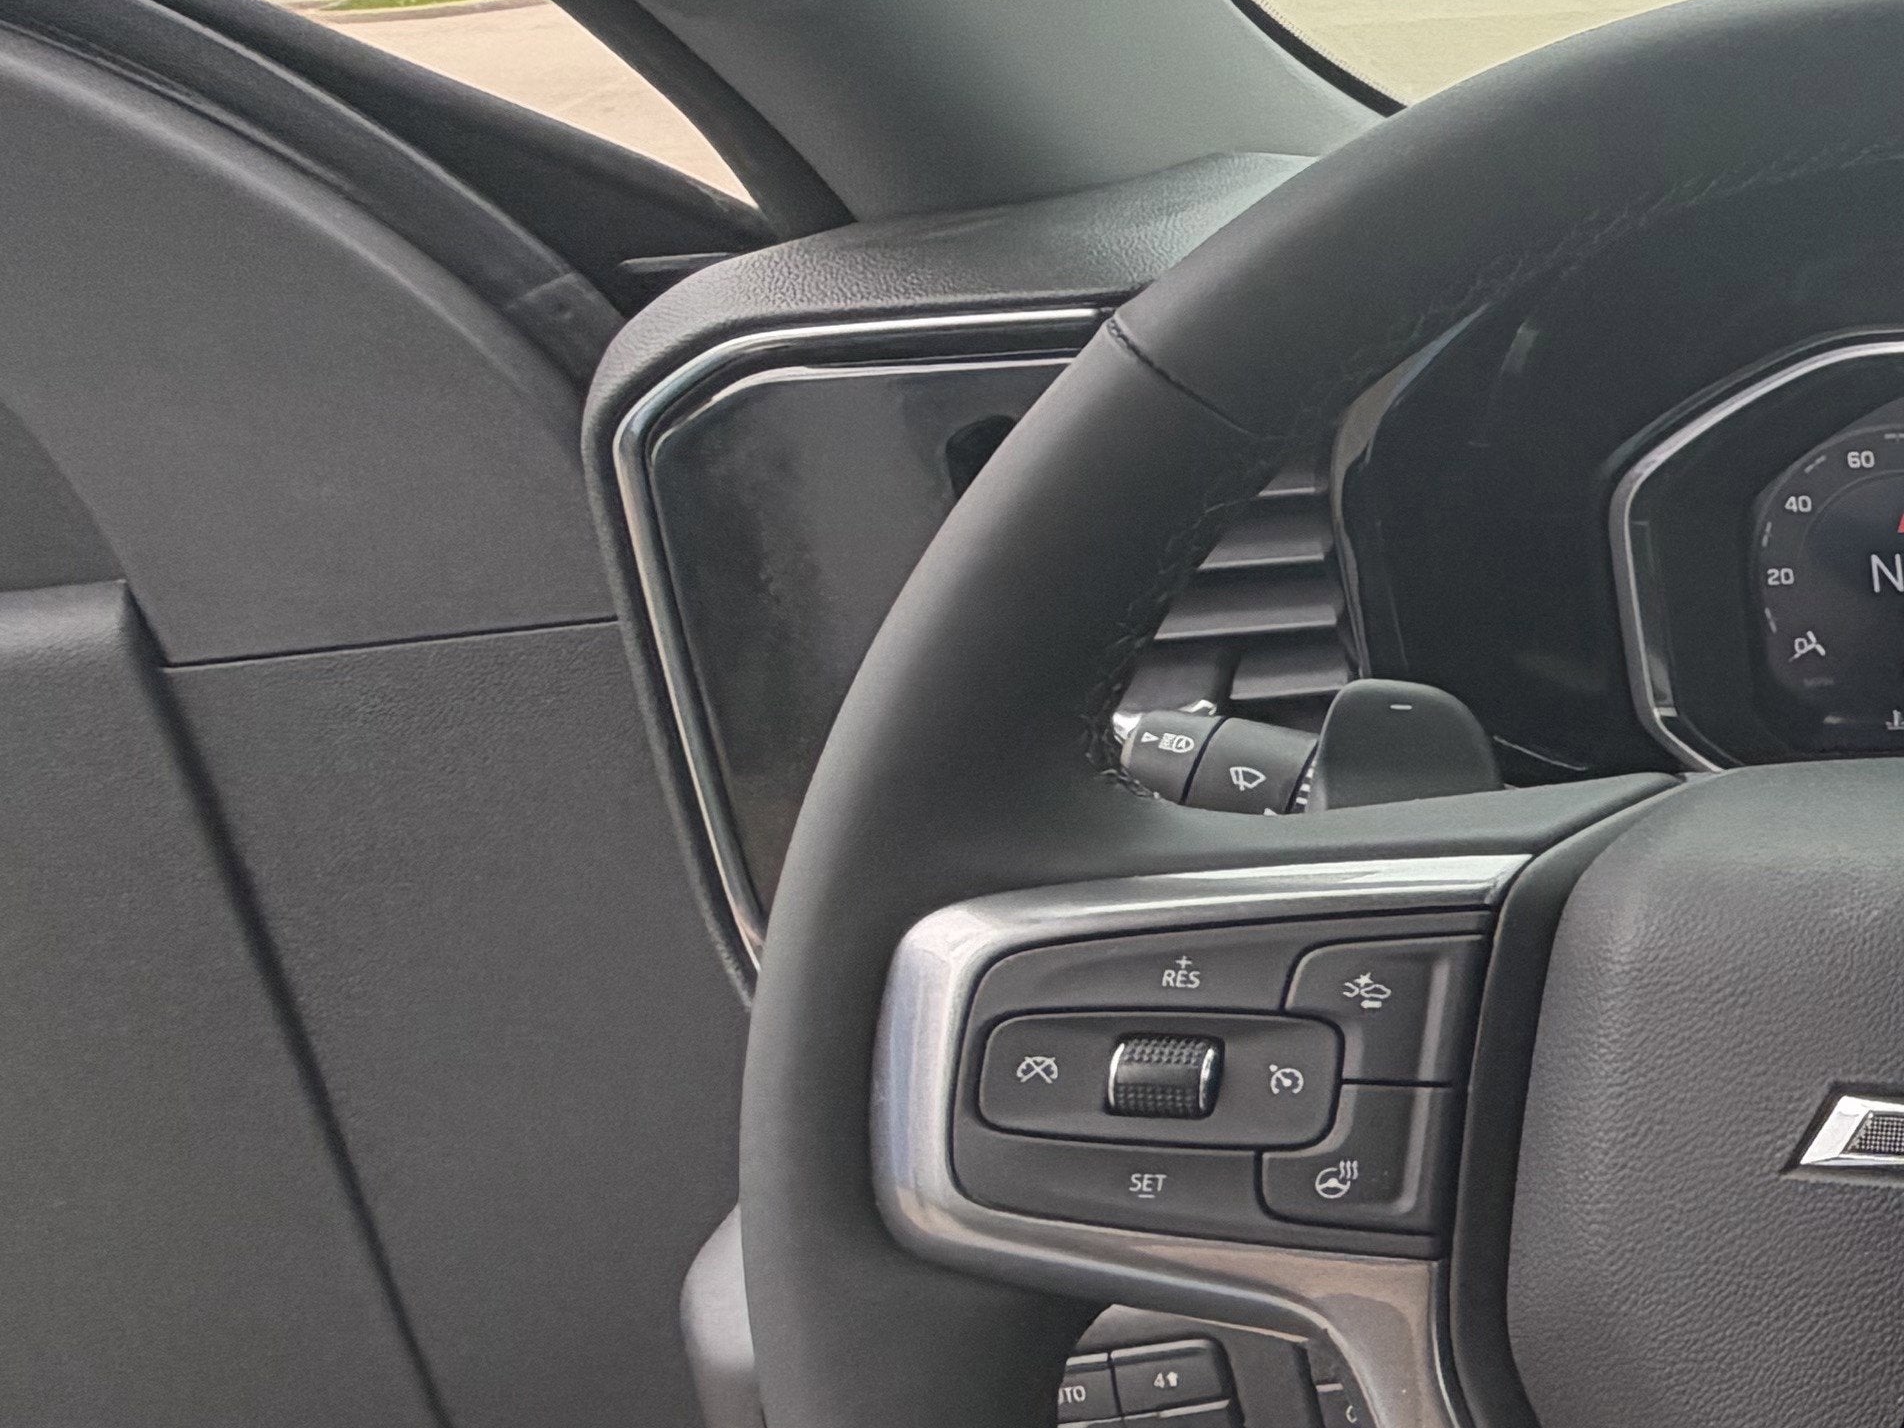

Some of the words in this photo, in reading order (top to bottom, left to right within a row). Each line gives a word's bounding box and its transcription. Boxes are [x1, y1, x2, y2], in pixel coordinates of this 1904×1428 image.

[1847, 451, 1875, 469] 60
[1784, 496, 1812, 514] 40
[1767, 569, 1795, 586] 20
[1162, 969, 1200, 989] RES
[1129, 1174, 1166, 1193] SET
